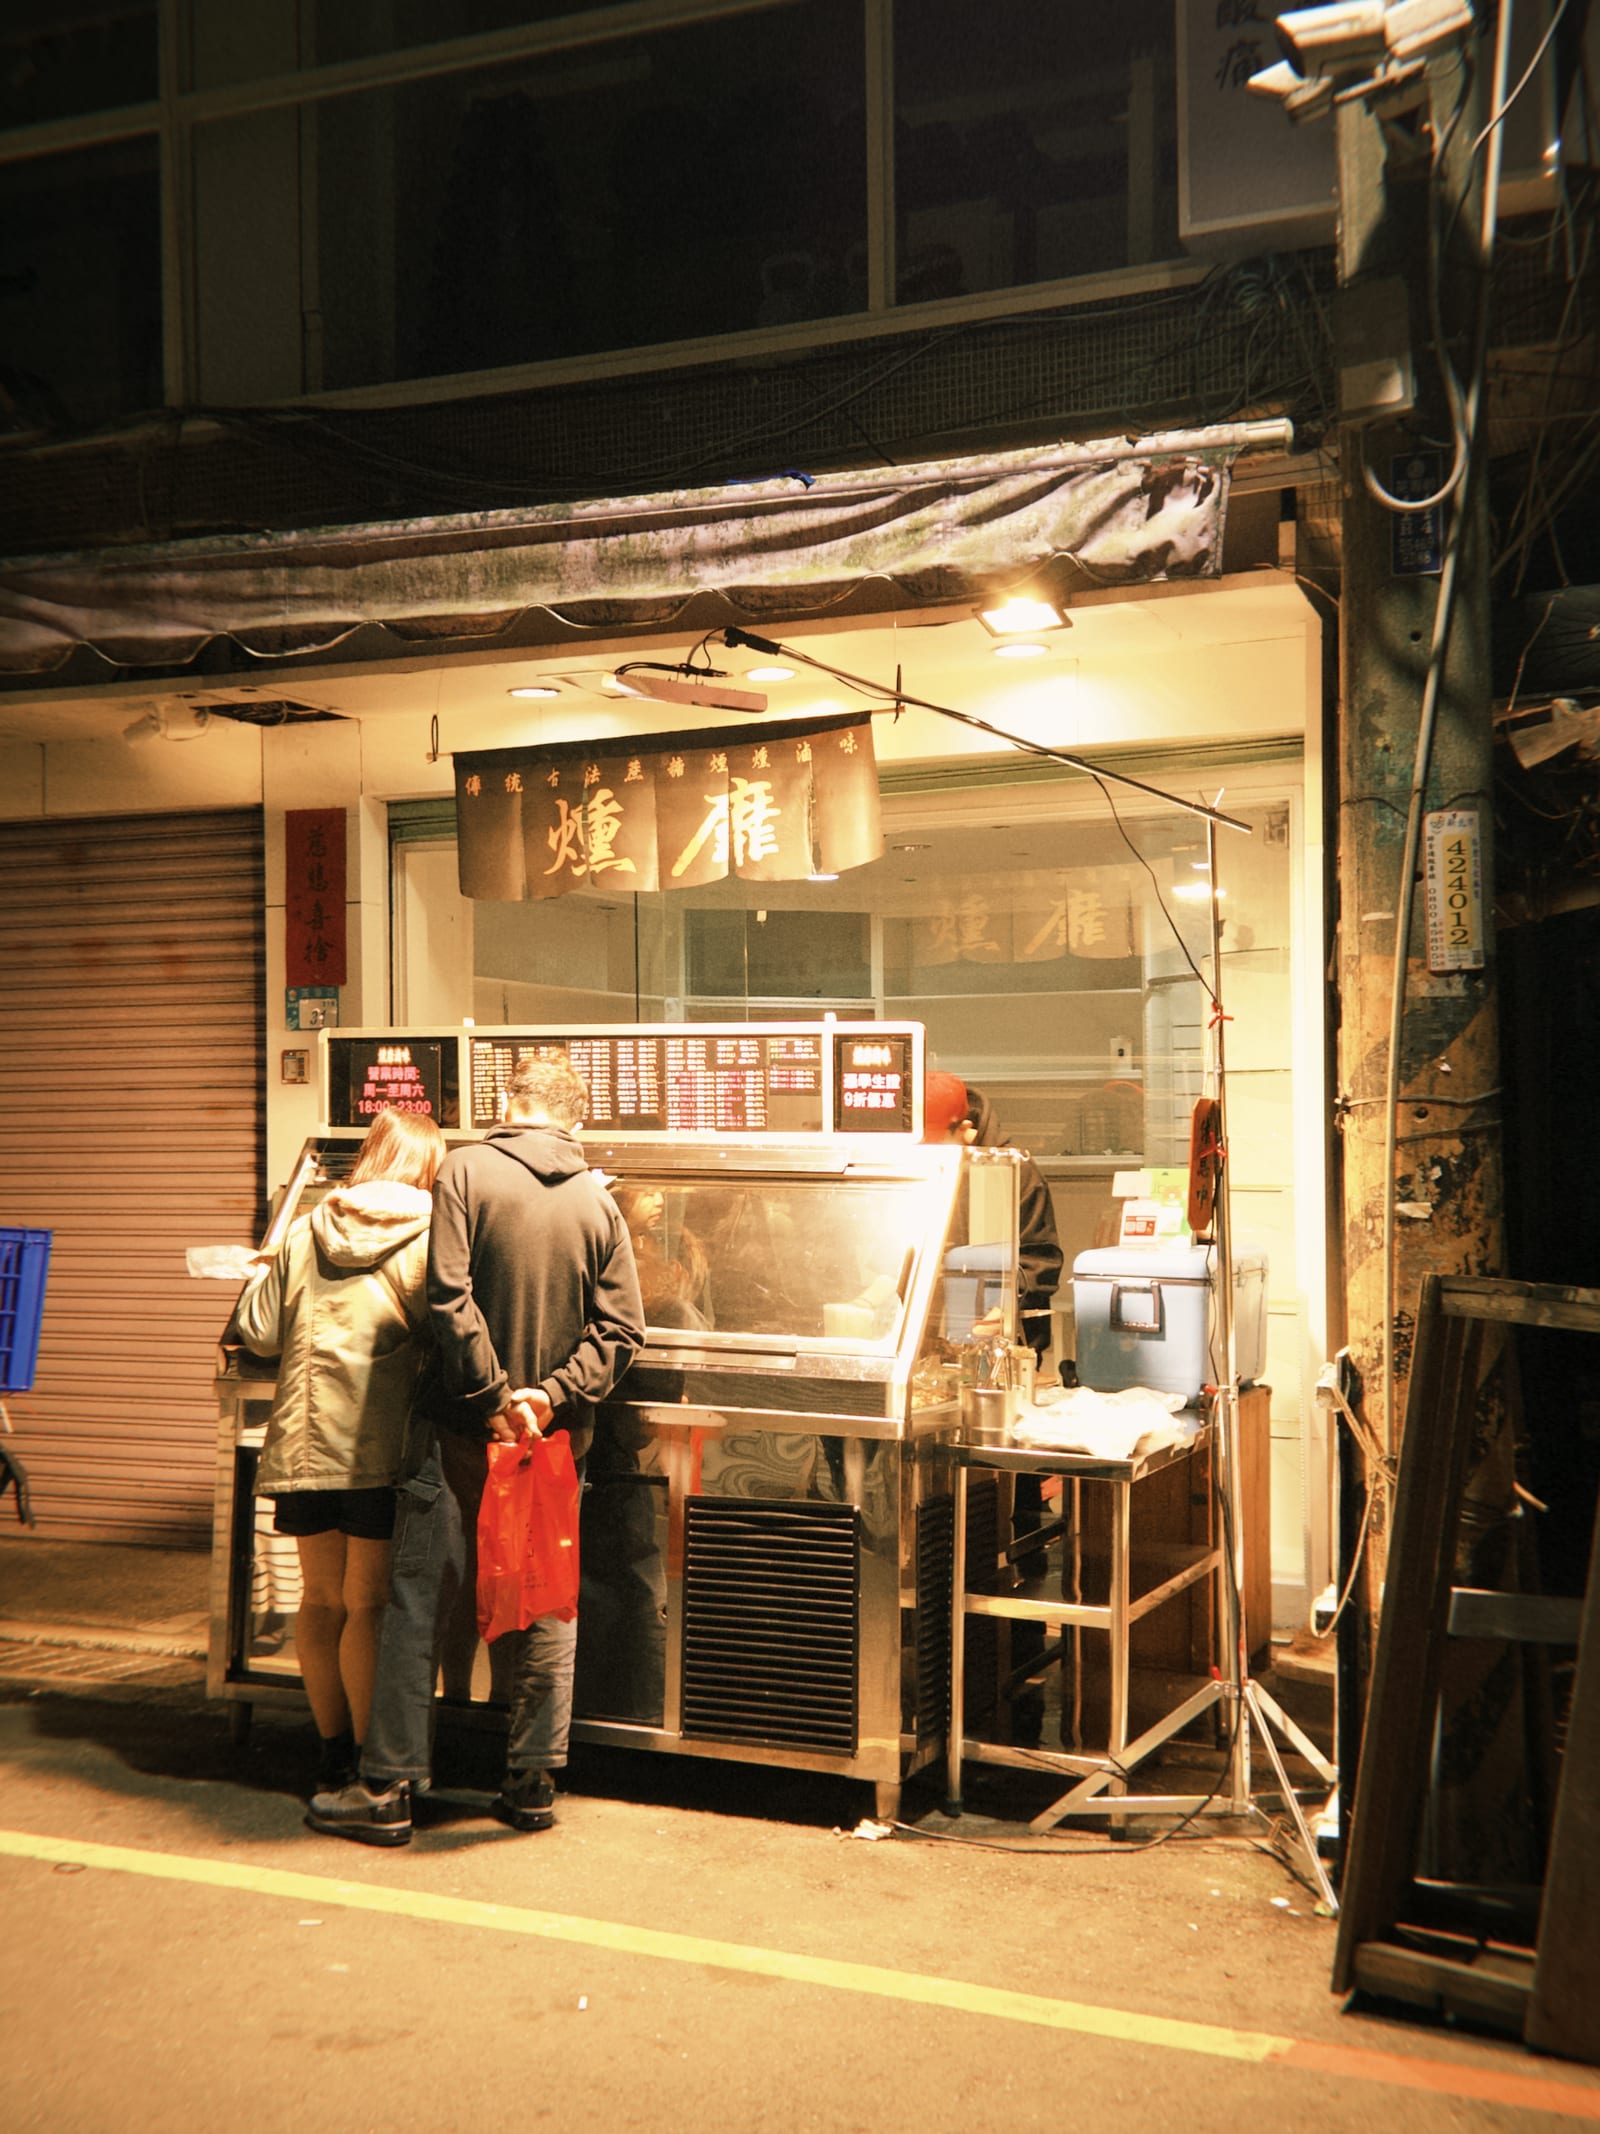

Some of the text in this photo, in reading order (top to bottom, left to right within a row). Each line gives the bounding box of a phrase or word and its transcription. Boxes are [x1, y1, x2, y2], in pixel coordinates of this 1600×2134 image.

[1447, 839, 1469, 945] 424012
[363, 1083, 425, 1098] 周一至周六
